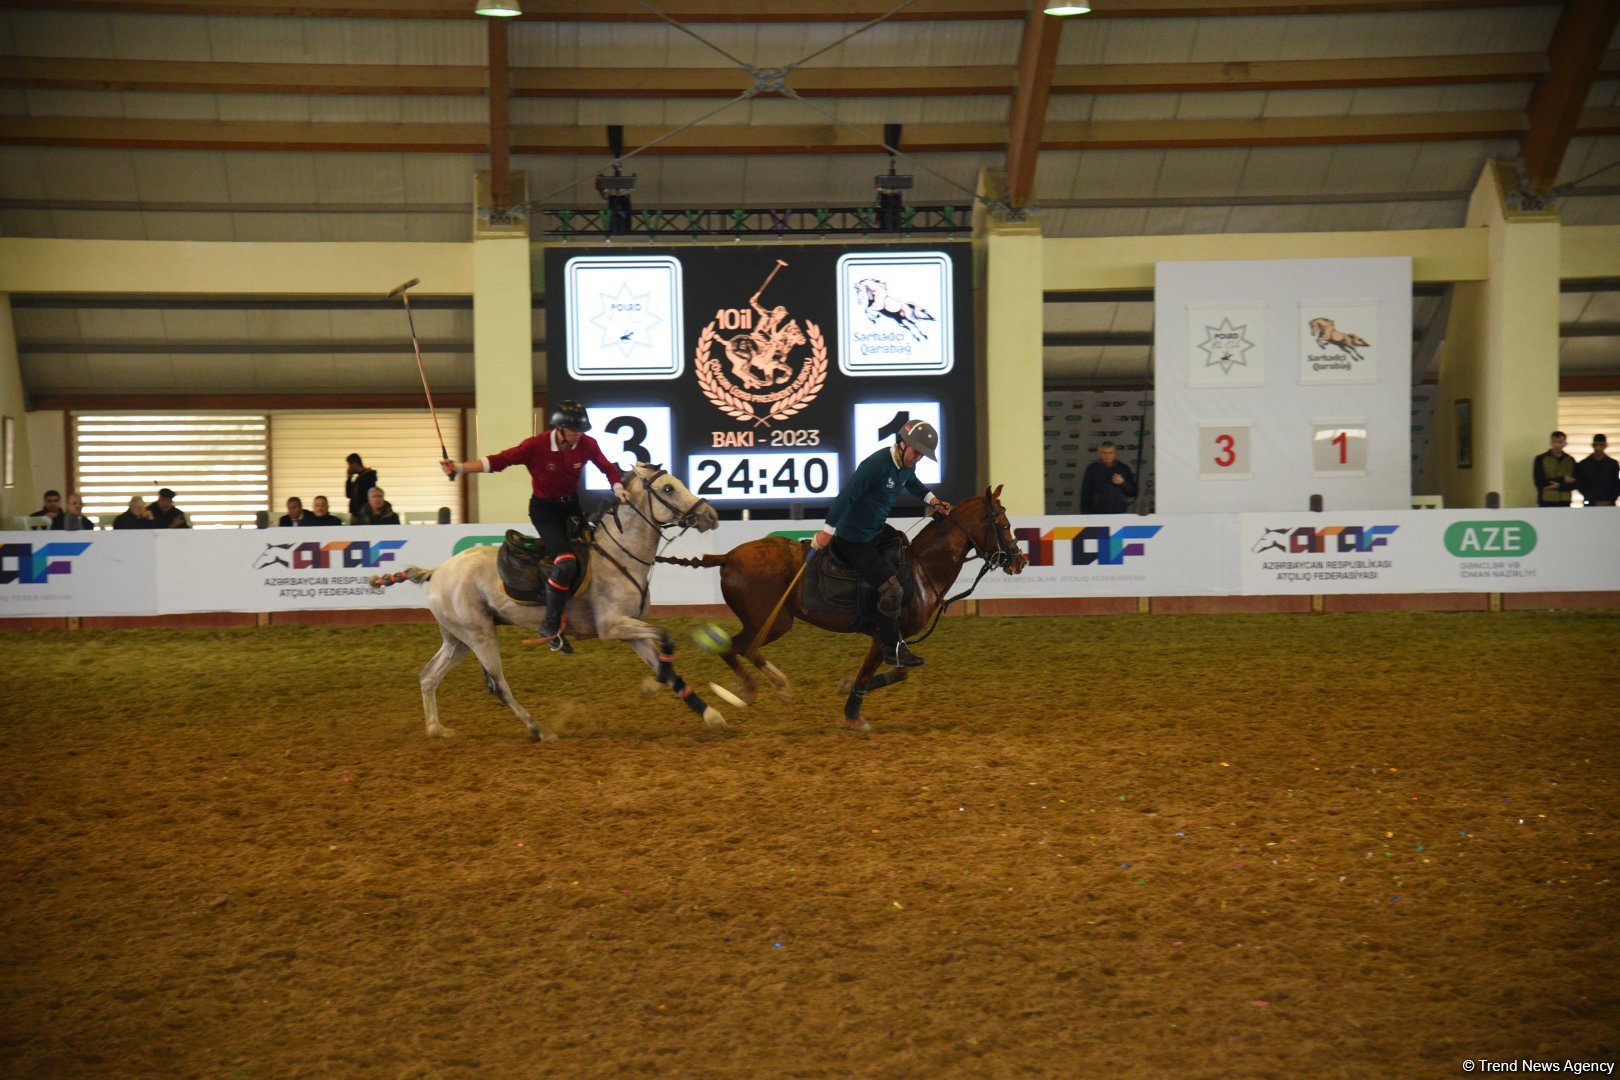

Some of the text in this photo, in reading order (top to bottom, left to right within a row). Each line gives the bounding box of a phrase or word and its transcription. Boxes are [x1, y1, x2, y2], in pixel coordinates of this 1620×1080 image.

[604, 415, 652, 475] 3
[711, 431, 755, 448] BAKI
[770, 429, 821, 447] 2023
[1214, 434, 1236, 467] 3
[1331, 432, 1348, 464] 1
[697, 457, 829, 496] 24:40
[1460, 527, 1522, 551] AZE
